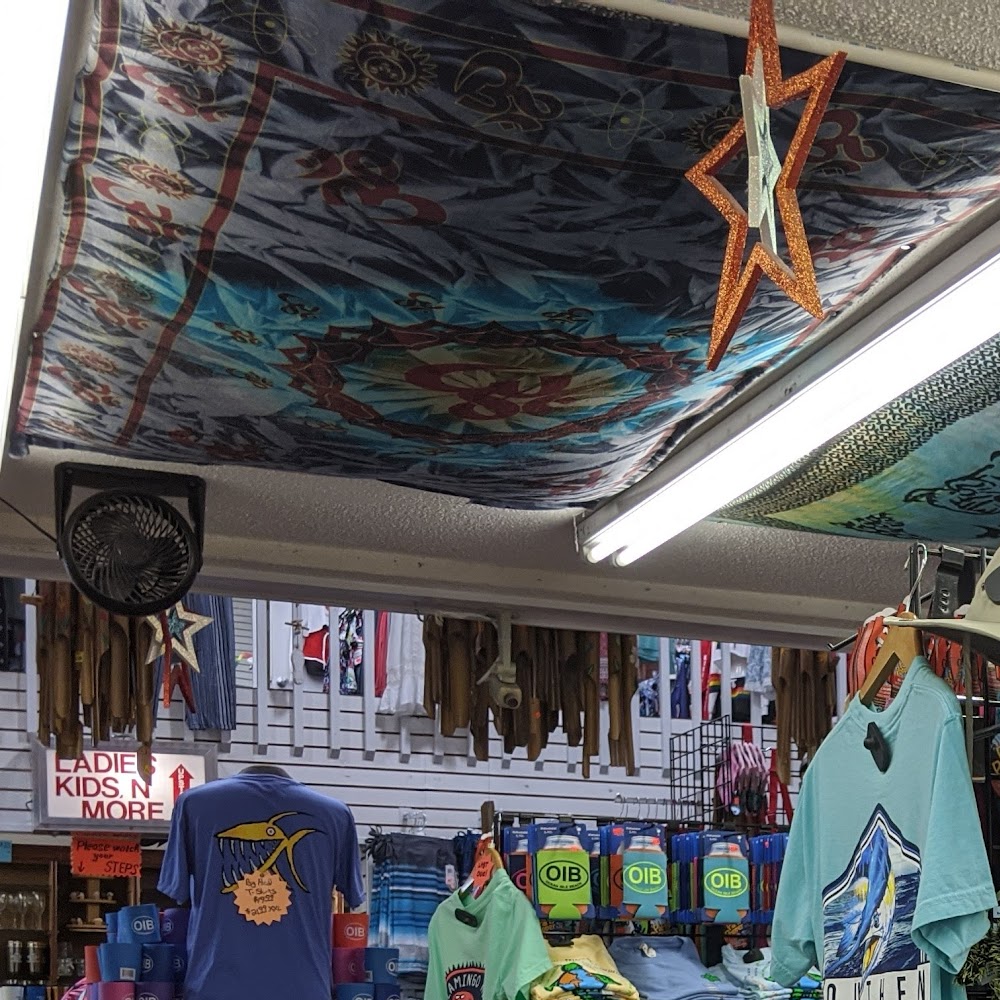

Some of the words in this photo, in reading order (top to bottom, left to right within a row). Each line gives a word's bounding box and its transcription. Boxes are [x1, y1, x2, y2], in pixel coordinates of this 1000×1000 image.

[55, 752, 157, 774] LADIE
[82, 800, 165, 821] MORE
[76, 840, 111, 852] Please
[92, 853, 114, 862] your
[104, 861, 139, 876] STEPS
[546, 865, 582, 882] OIB
[628, 866, 662, 885] OIB
[710, 872, 742, 889] OIB
[133, 919, 155, 932] OIB
[346, 926, 365, 937] OIB
